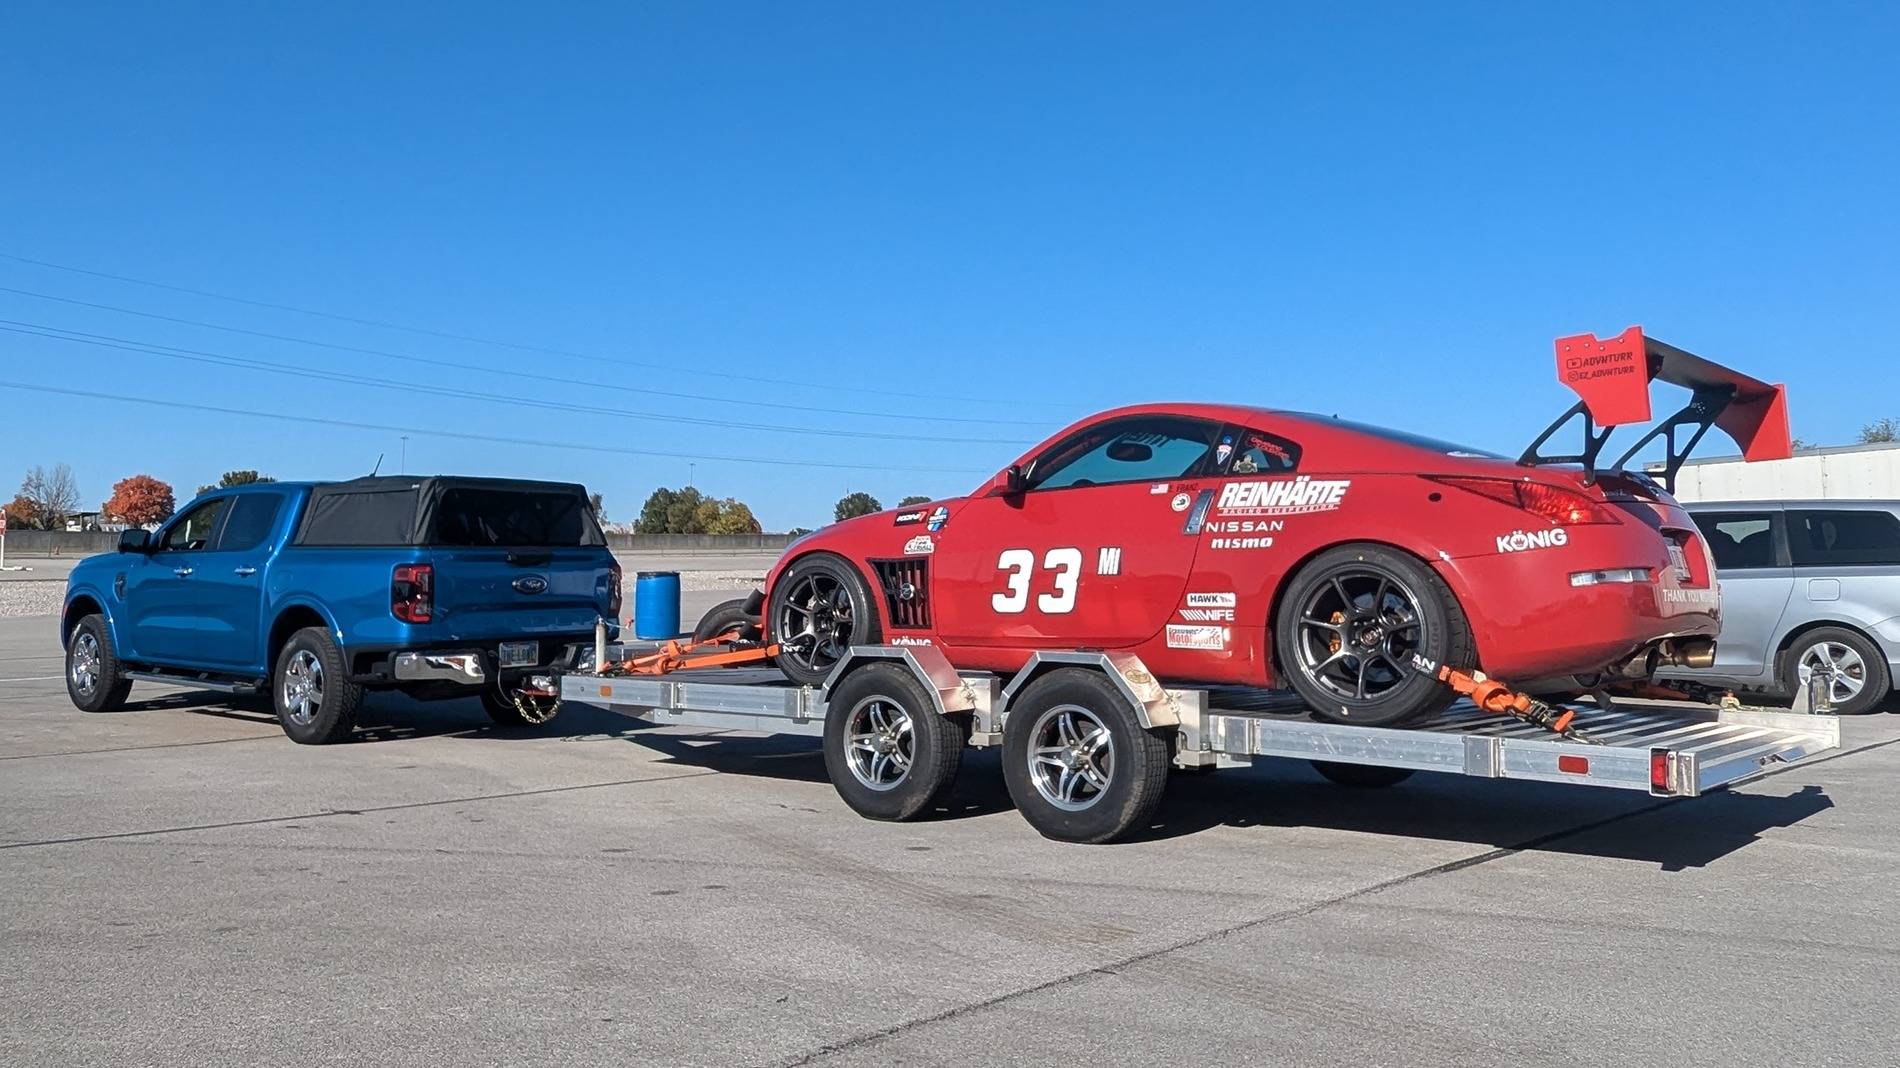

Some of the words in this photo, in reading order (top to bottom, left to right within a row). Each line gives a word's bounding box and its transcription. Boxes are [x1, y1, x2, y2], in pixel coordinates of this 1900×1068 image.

[1217, 476, 1350, 507] REINHÄRTE
[1206, 521, 1284, 532] NISSAN
[1211, 537, 1273, 548] nismo
[1496, 528, 1568, 553] KÖNIG
[991, 547, 1082, 614] 33
[1190, 595, 1218, 603] HAWK
